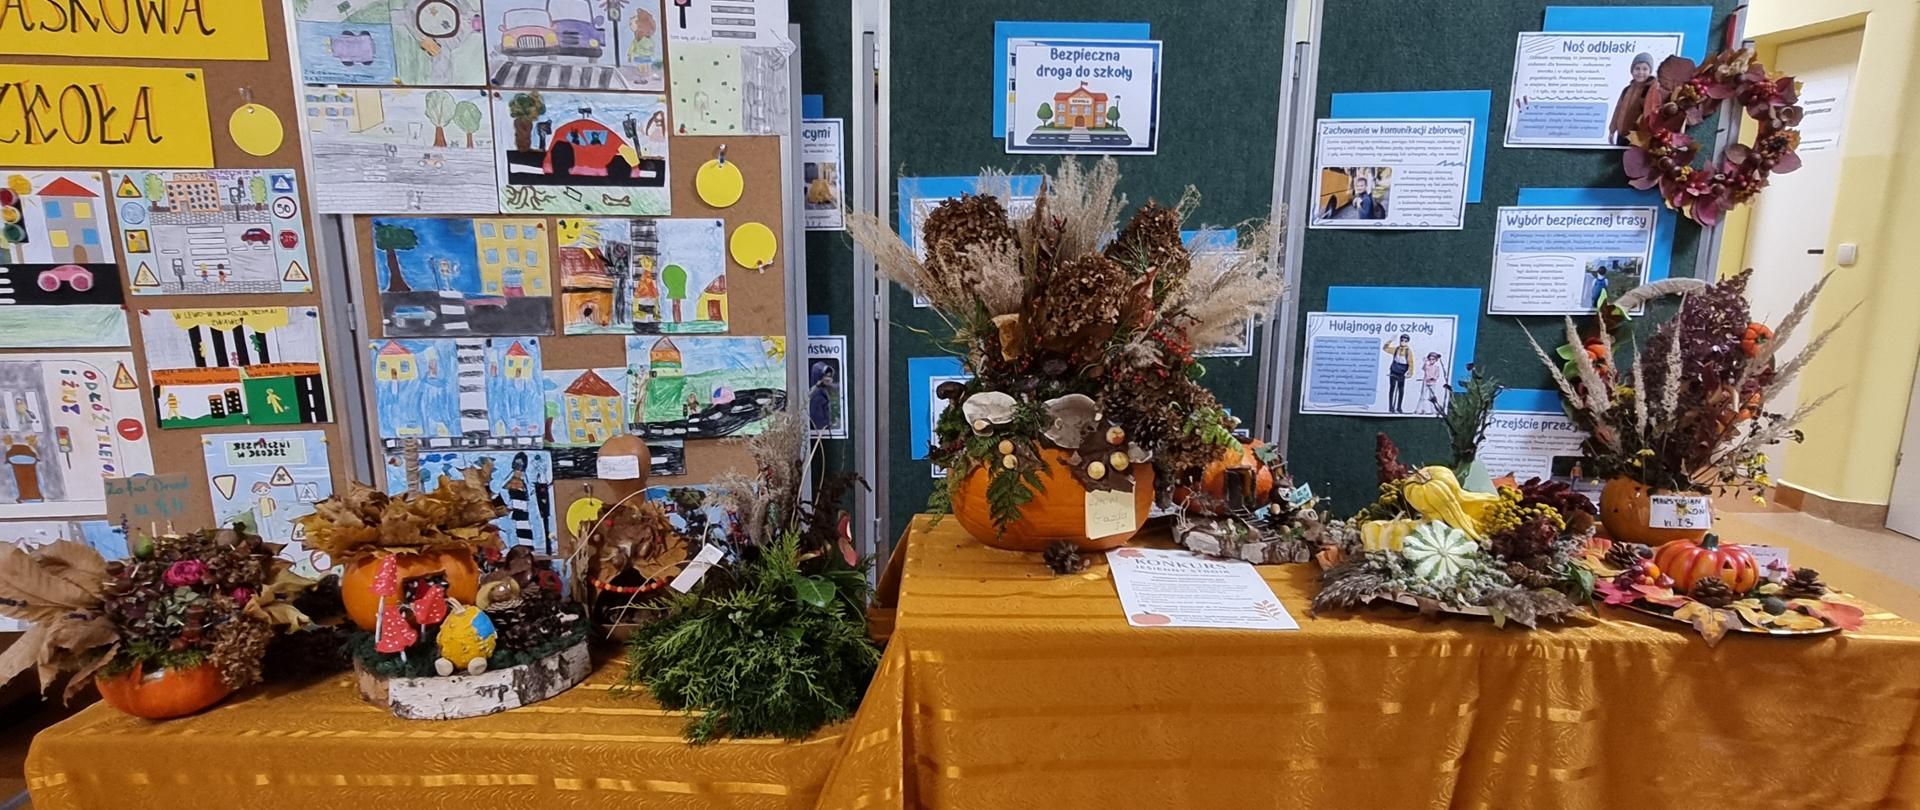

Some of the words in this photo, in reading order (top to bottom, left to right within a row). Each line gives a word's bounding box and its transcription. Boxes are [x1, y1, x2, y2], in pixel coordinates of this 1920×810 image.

[1563, 40, 1585, 54] Noś
[1587, 40, 1637, 54] odblaski
[1050, 47, 1120, 64] Bezpieczna
[1036, 64, 1073, 80] droga
[1075, 65, 1091, 78] do
[1093, 65, 1133, 82] szkoły
[803, 127, 832, 142] cymi
[1322, 125, 1370, 136] Zachowanie
[1371, 127, 1379, 135] w
[1380, 125, 1427, 136] komunikacji
[1428, 125, 1467, 136] zbiorowej
[1506, 213, 1545, 229] Wybór
[1546, 213, 1613, 229] bezpiecznej
[1615, 214, 1647, 229] trasy
[1329, 320, 1382, 335] Hulajnogą
[1384, 321, 1398, 333] do
[1399, 322, 1434, 336] szkoły
[1489, 416, 1539, 431] Przejście
[1541, 420, 1573, 433] przez
[1135, 558, 1227, 570] KONKURS
